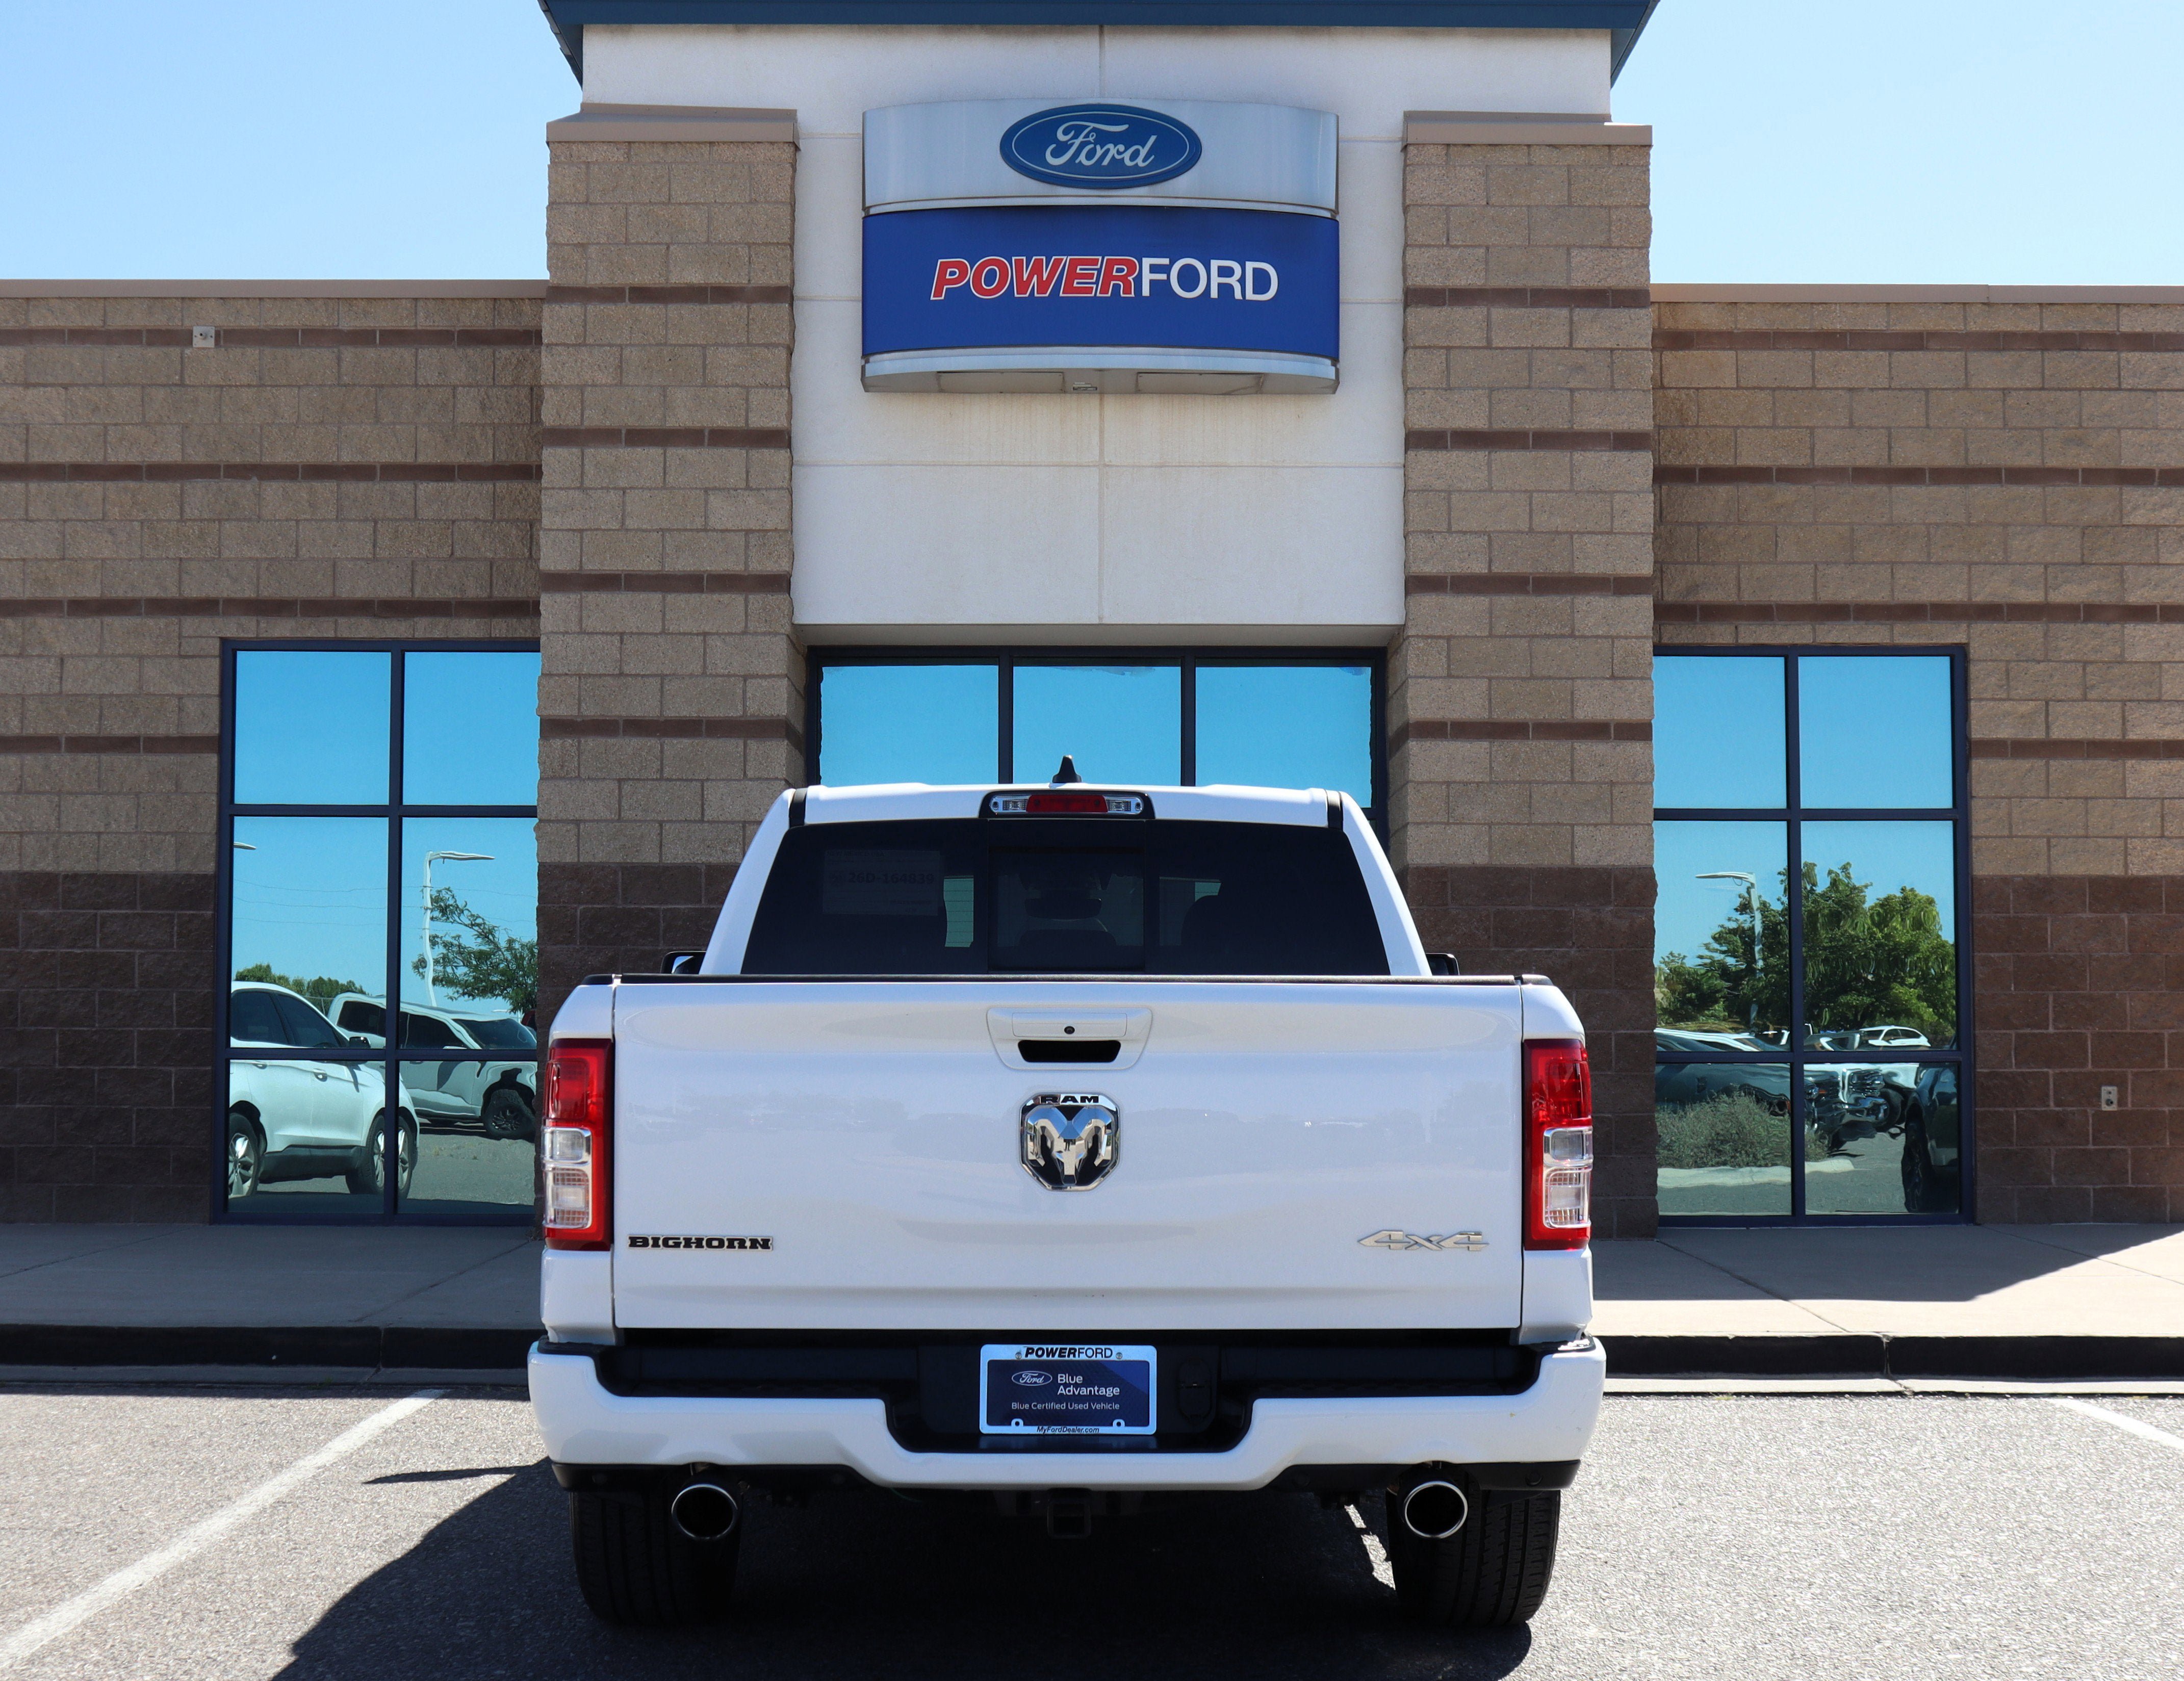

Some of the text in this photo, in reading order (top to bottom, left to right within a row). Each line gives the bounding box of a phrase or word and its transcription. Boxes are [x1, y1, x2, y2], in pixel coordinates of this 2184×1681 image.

[1045, 121, 1156, 167] Ford
[931, 256, 1278, 300] POWERFORD
[1040, 1095, 1099, 1103] RAM
[628, 1236, 771, 1250] BIGHORN
[1025, 1347, 1113, 1358] POWERFORD
[1019, 1373, 1045, 1383] Ford
[1058, 1374, 1083, 1383] Blue
[1057, 1385, 1120, 1397] Advantage
